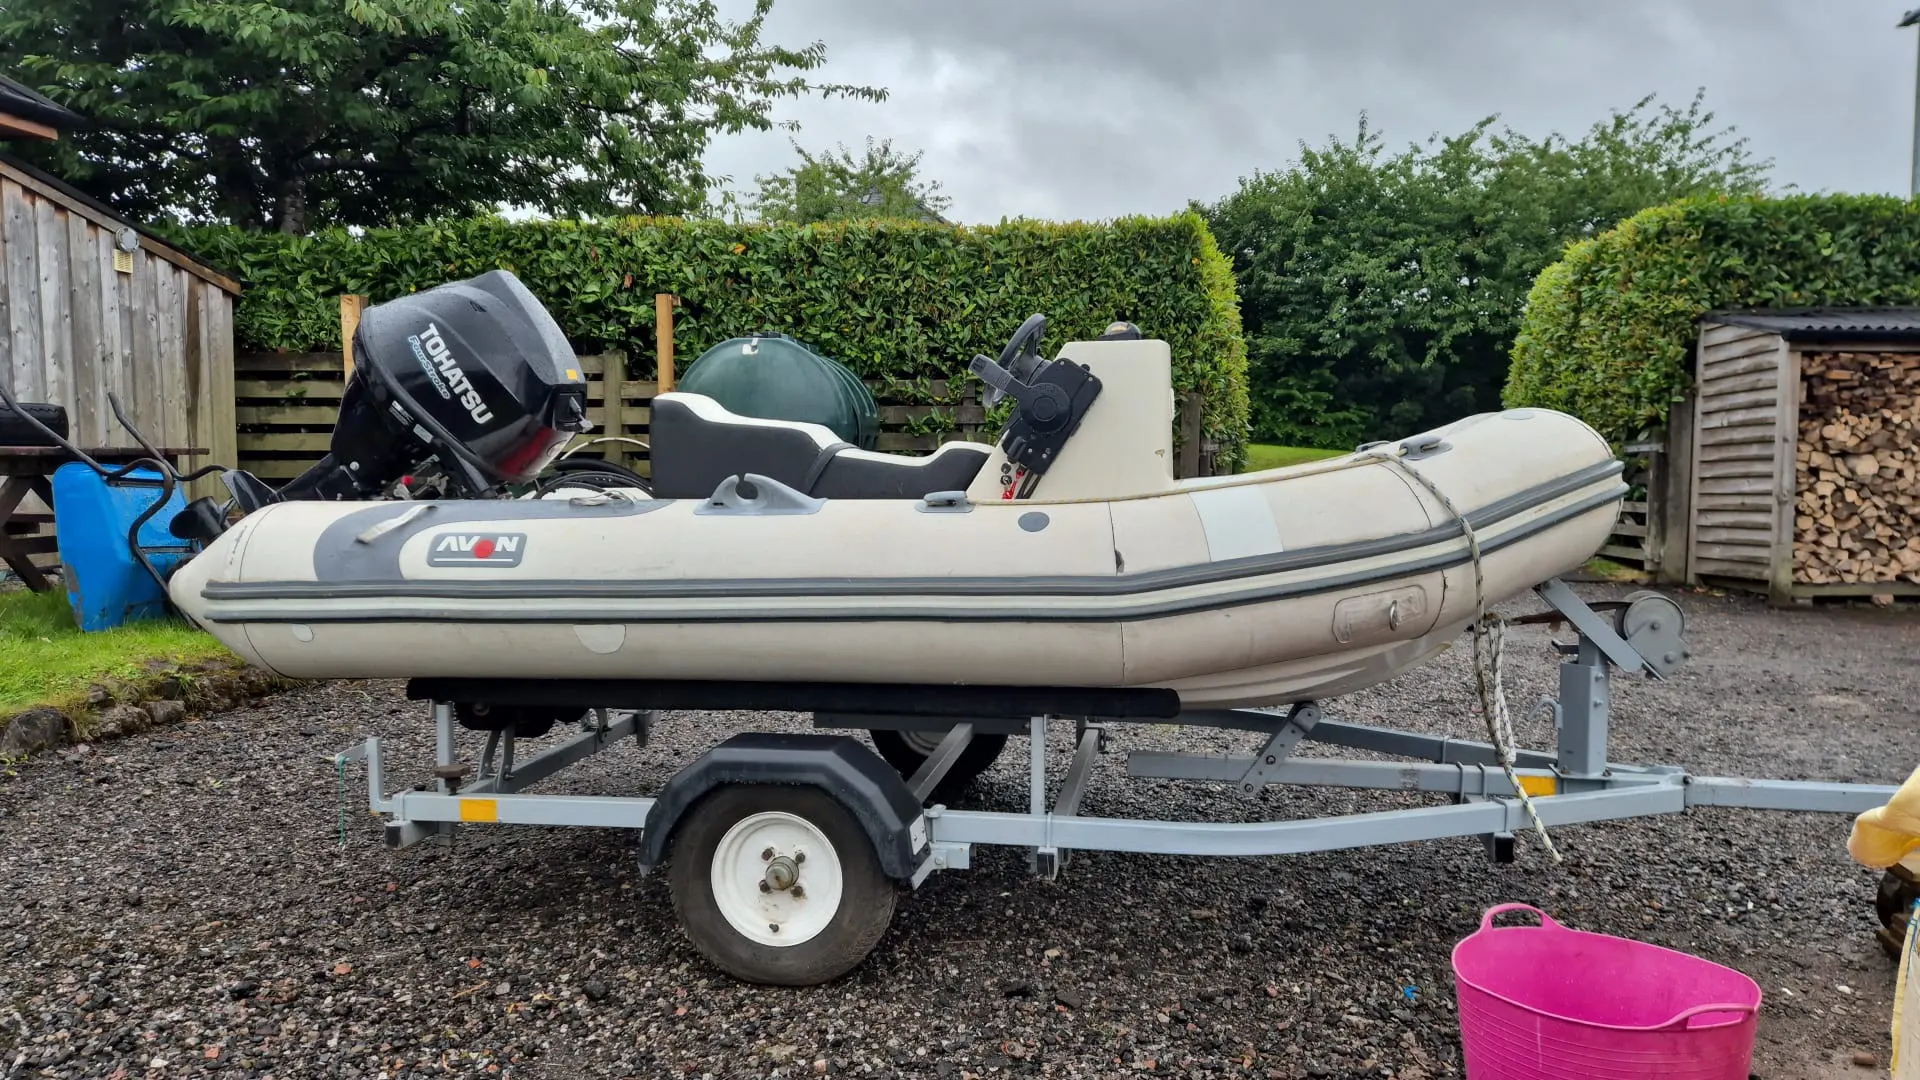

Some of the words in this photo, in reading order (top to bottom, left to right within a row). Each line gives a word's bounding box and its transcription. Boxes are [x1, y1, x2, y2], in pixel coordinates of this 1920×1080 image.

[408, 335, 451, 400] FourStroke
[420, 322, 494, 424] TOHATSU
[436, 535, 519, 559] AVON
